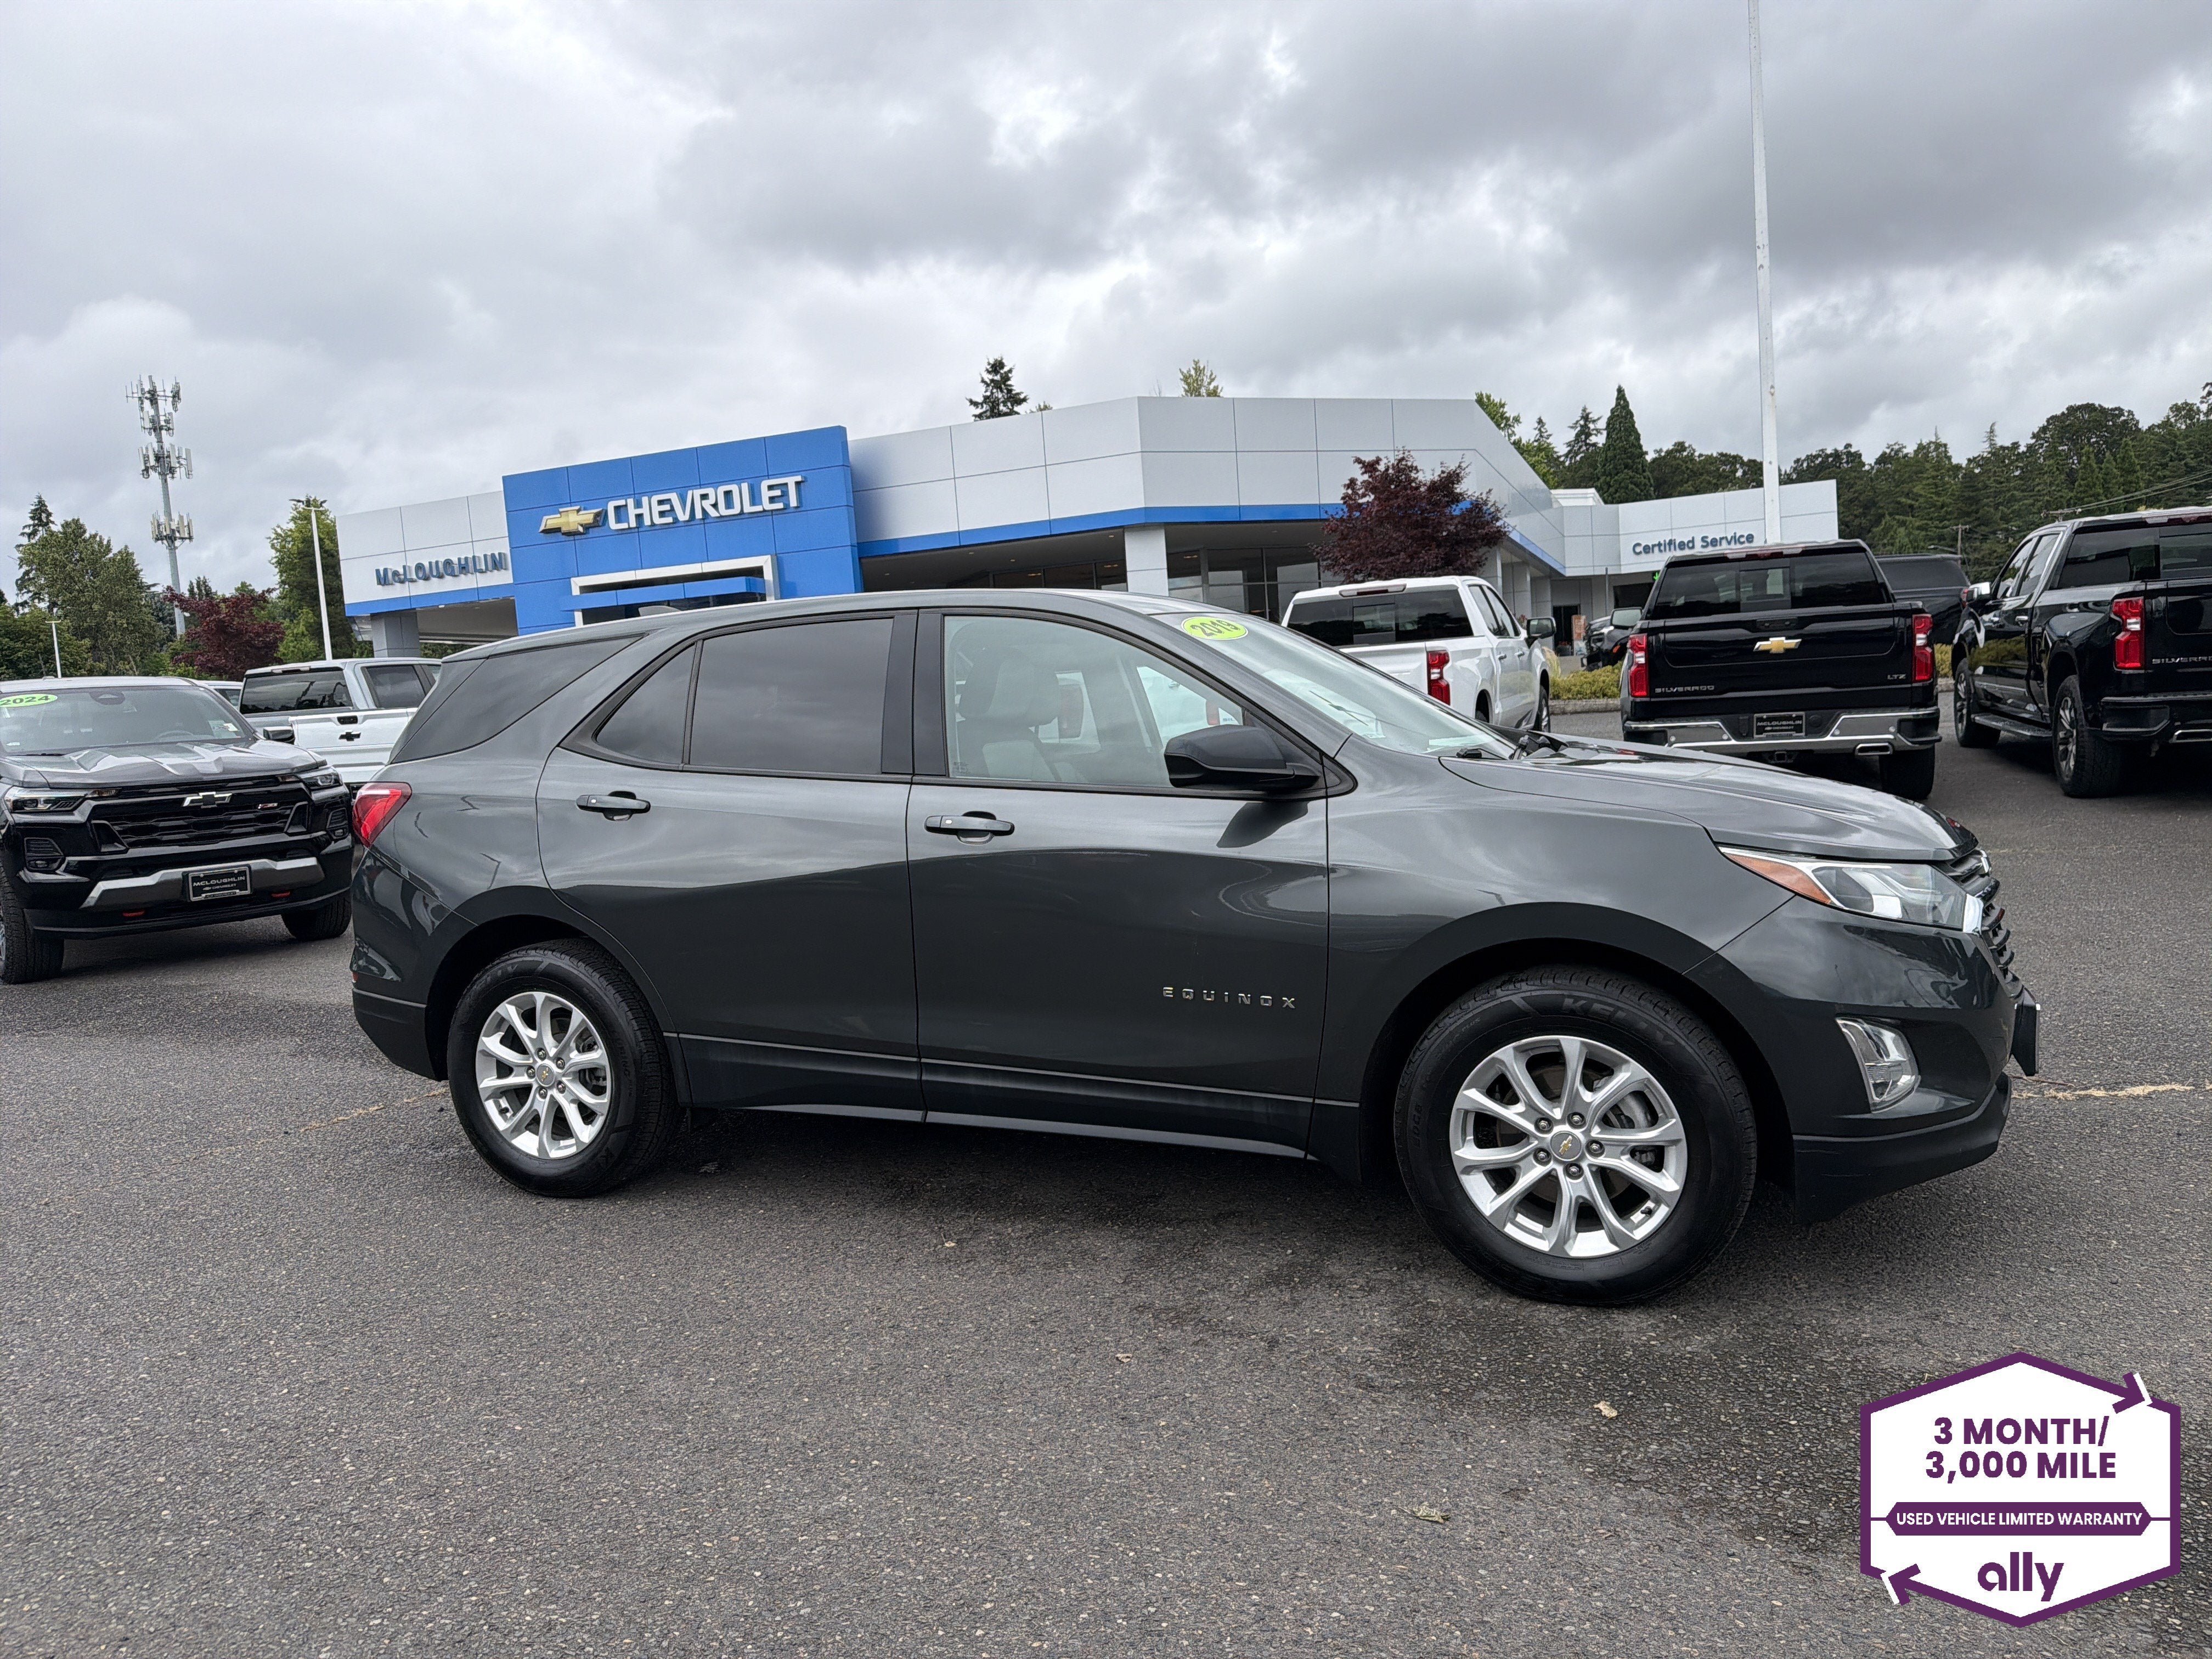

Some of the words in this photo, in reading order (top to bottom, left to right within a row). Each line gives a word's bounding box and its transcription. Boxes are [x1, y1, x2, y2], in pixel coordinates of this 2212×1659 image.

[607, 475, 803, 530] CHEVROLET
[1632, 536, 1695, 556] Certified
[1700, 532, 1754, 549] Service
[375, 552, 509, 586] McLOUGHLIN
[1189, 619, 1241, 637] 2019
[1655, 685, 1714, 693] SILVERADO
[0, 695, 50, 706] 2024
[193, 876, 245, 887] MCLOUGHLIN
[1162, 987, 1296, 1009] EQUINOX
